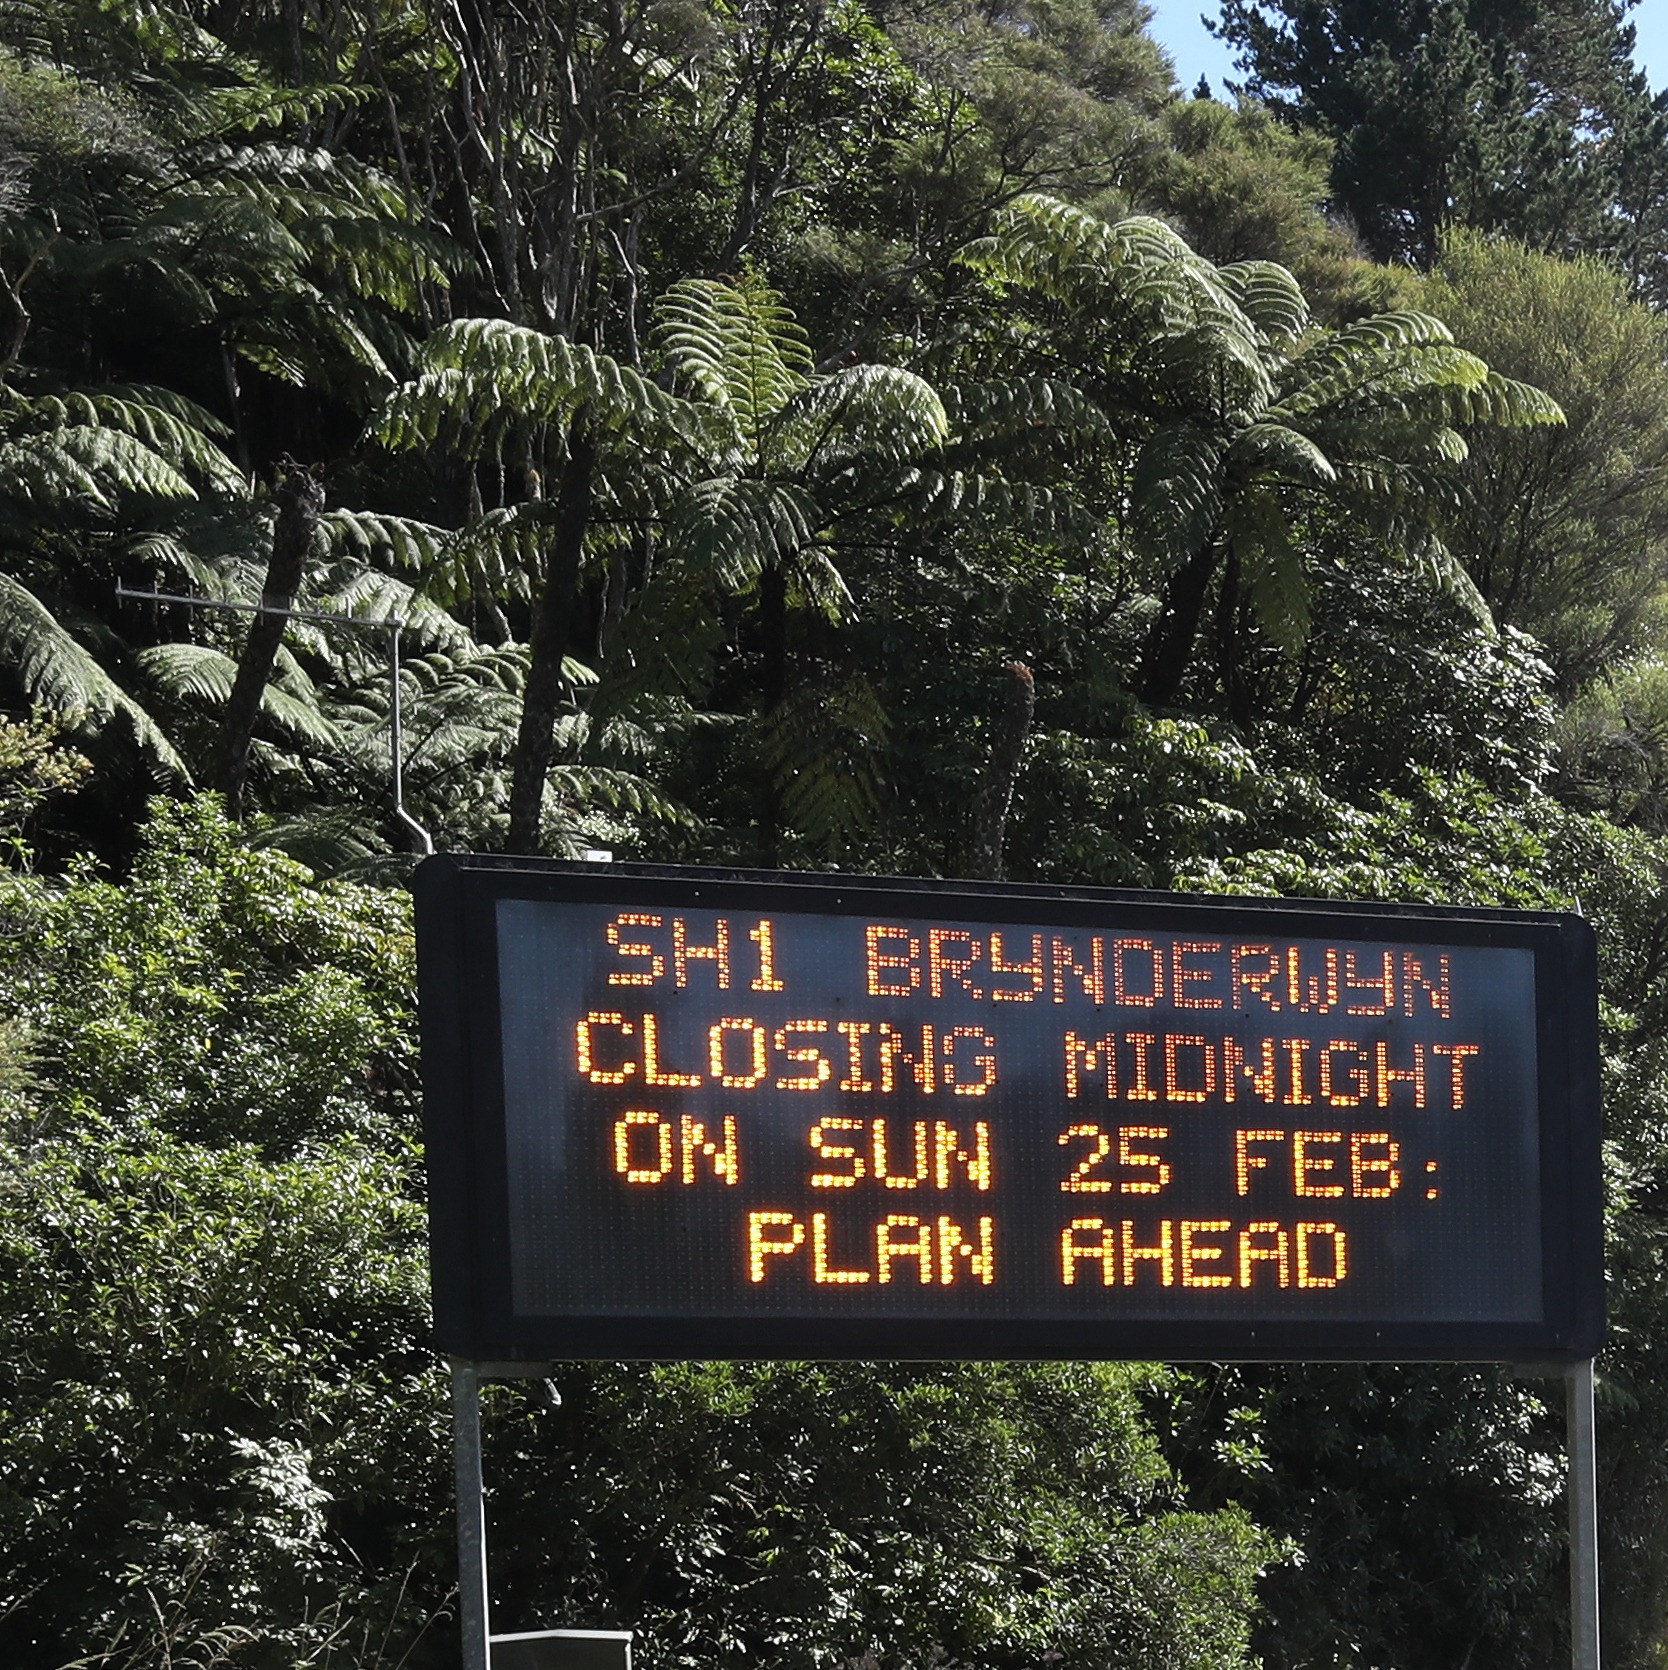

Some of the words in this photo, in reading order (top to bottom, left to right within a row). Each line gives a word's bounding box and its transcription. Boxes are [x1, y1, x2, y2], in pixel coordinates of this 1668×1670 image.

[606, 913, 786, 993] SH1
[865, 924, 1450, 1020] BRYNDERWYN
[575, 1011, 998, 1099] CLOSING
[1064, 1030, 1481, 1111] MIDNIGHT
[613, 1110, 741, 1187] ON
[807, 1117, 993, 1194] SUN
[1058, 1123, 1173, 1196] 25
[745, 1210, 996, 1288] PLAN
[1060, 1216, 1350, 1291] AHEAD
